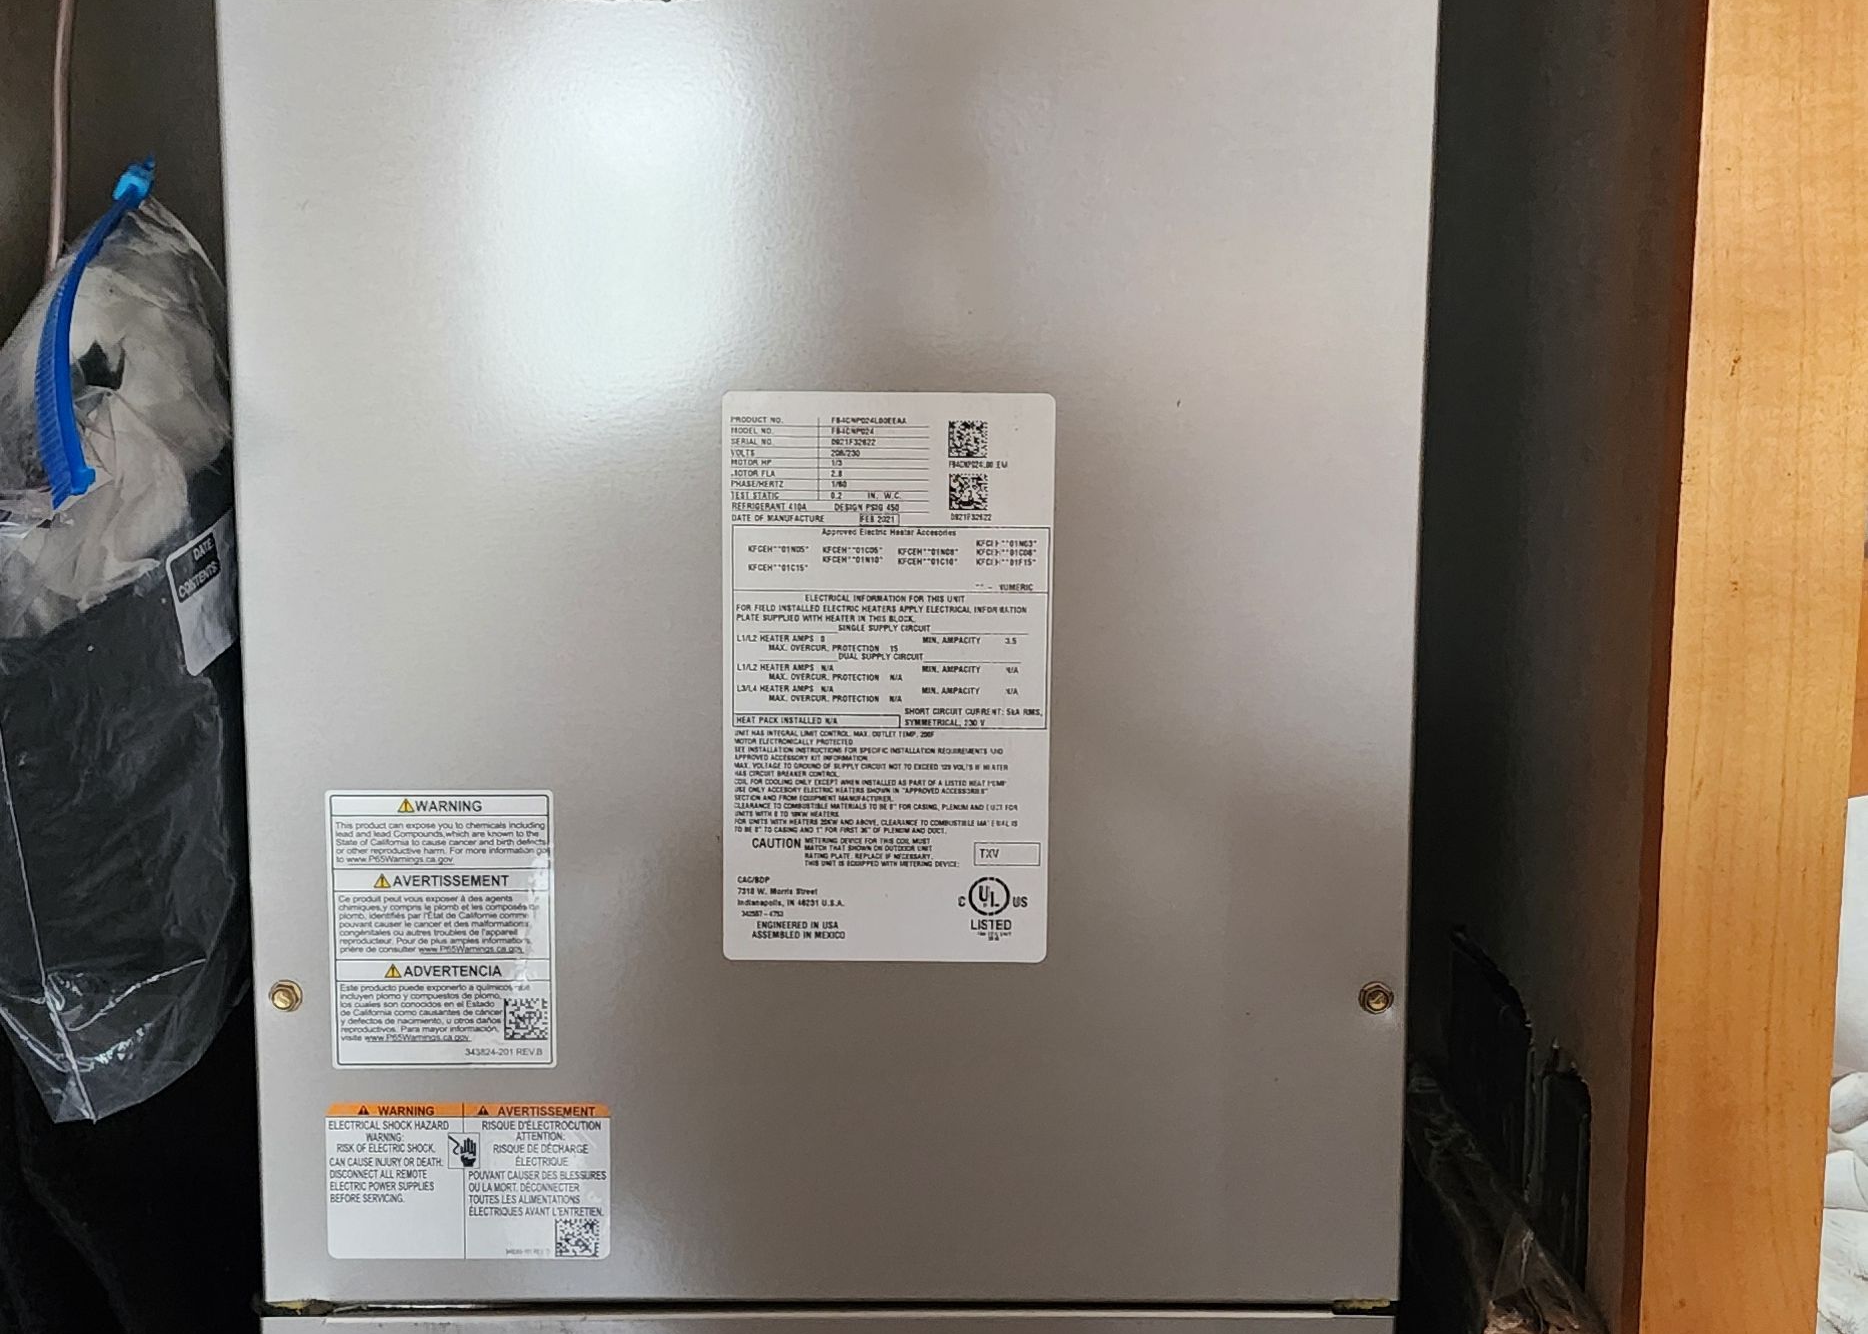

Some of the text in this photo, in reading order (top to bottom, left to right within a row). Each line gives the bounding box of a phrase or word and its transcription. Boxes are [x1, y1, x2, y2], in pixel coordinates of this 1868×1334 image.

[731, 513, 825, 523] DATE OF MANUFACTURE
[192, 537, 214, 562] DATE
[178, 560, 219, 599] CONTENTS
[415, 800, 483, 812] WARNING
[751, 837, 802, 849] CAUTION
[979, 848, 1000, 859] TXV
[393, 874, 510, 887] AVERTISSEMENT
[1012, 896, 1029, 908] US
[756, 920, 839, 930] ENGINEERED IN USA
[970, 919, 1012, 931] LISTED
[751, 930, 846, 940] ASSEMBLED IN MEXICO
[403, 965, 503, 977] ADVERTENCIA
[377, 1105, 435, 1118] WARNING
[497, 1106, 596, 1117] AVERTISSEMENT
[328, 1120, 450, 1131] ELECTRICAL SHOCK HAZARD
[481, 1120, 516, 1131] RISQUE
[365, 1132, 404, 1142] WARNING:
[515, 1131, 566, 1141] ATTENTION:
[336, 1142, 438, 1154] RISK OF ELECTRIC SHOCK.
[492, 1142, 589, 1155] RISQUE DE DÉCHARGE
[328, 1156, 444, 1167] CAN CAUSE INJURY OR DEATH.
[329, 1169, 428, 1179] DISCONNECT ALL REMOTE
[468, 1170, 608, 1181] POUVANT CAUSER DES BLESSURES
[329, 1181, 435, 1192] ELECTRIC POWER SUPPLIES
[468, 1182, 481, 1193] OU
[481, 1182, 493, 1193] LA
[330, 1193, 406, 1204] BEFORE SERVICING.
[468, 1194, 581, 1205] TOUTES LES ALIMENTATIONS
